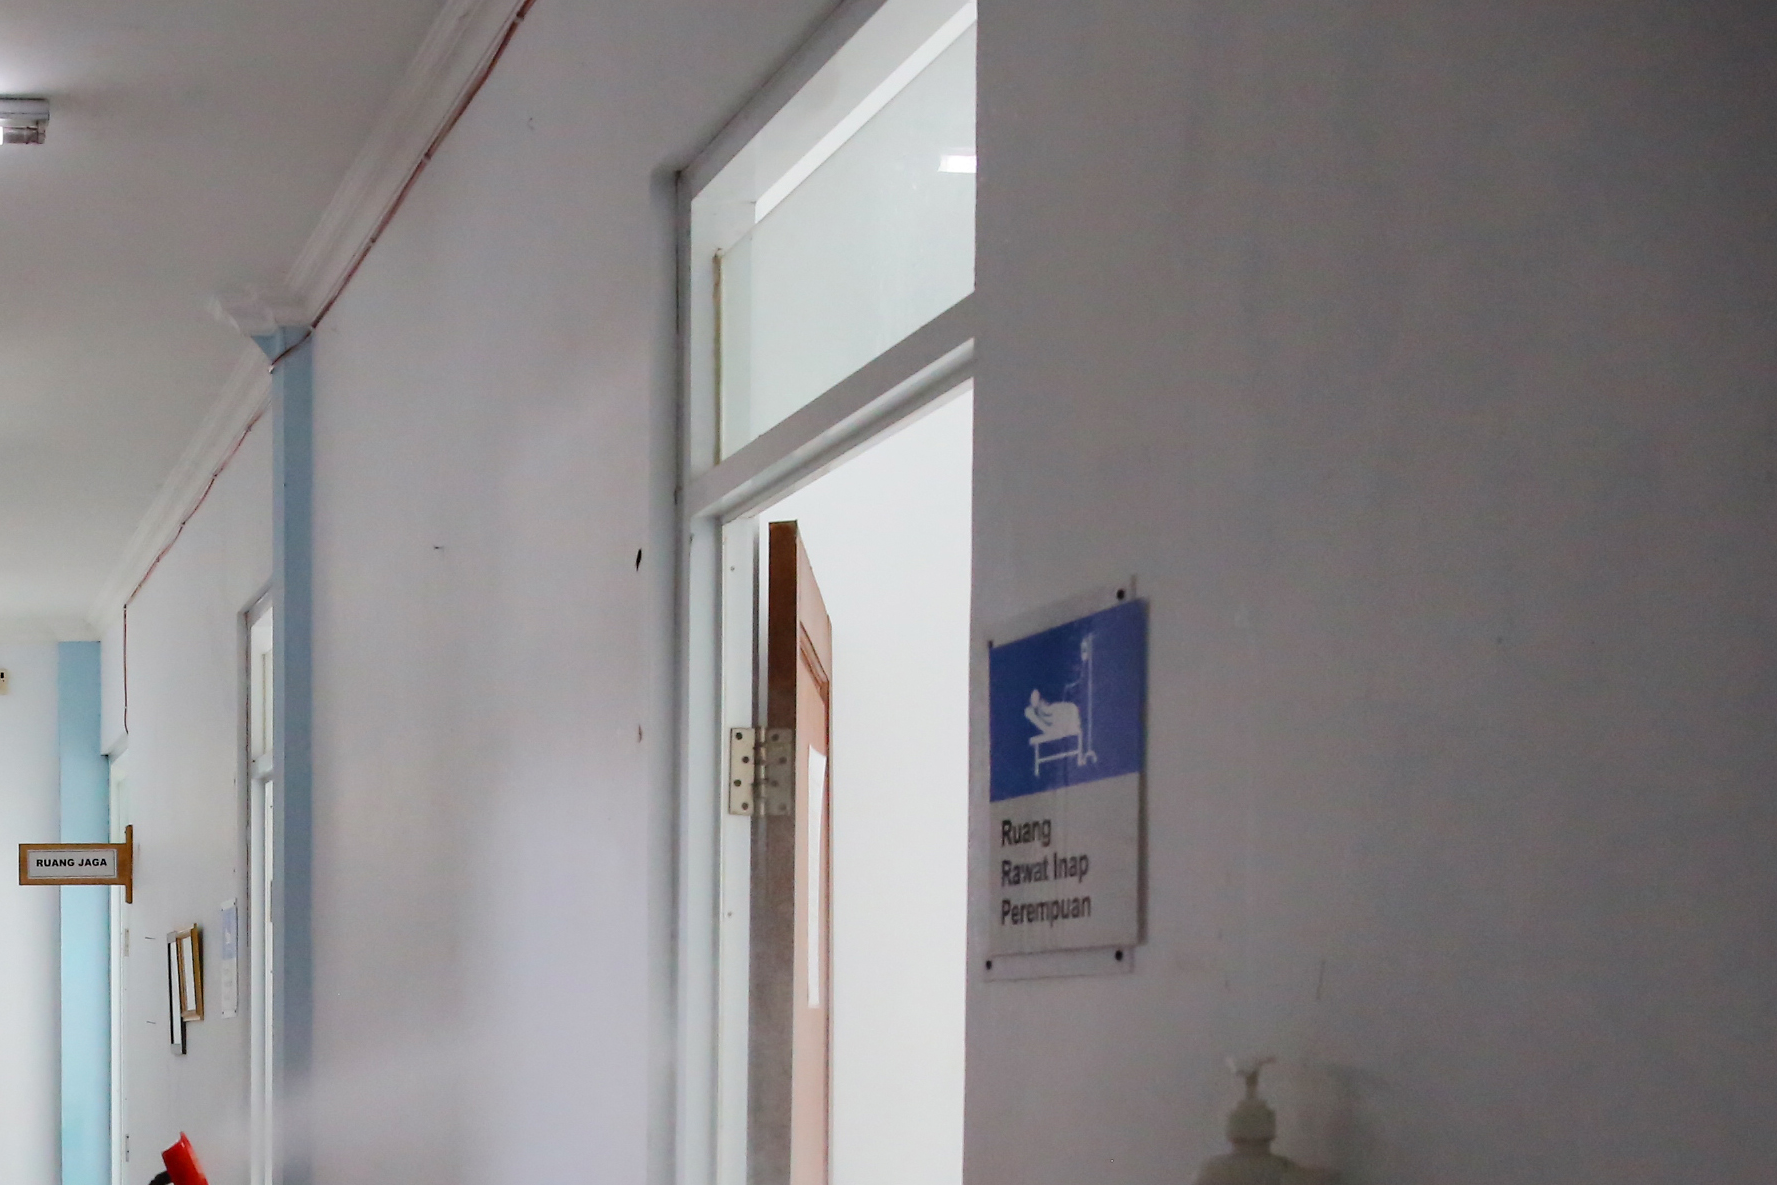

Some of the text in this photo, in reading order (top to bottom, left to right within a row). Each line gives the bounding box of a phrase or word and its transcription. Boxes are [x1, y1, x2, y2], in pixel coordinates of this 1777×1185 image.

[1001, 819, 1051, 848] Ruang
[36, 858, 108, 867] RUANG JAGA
[1001, 852, 1089, 887] Rawat Inap
[1001, 895, 1092, 928] Perempuan
